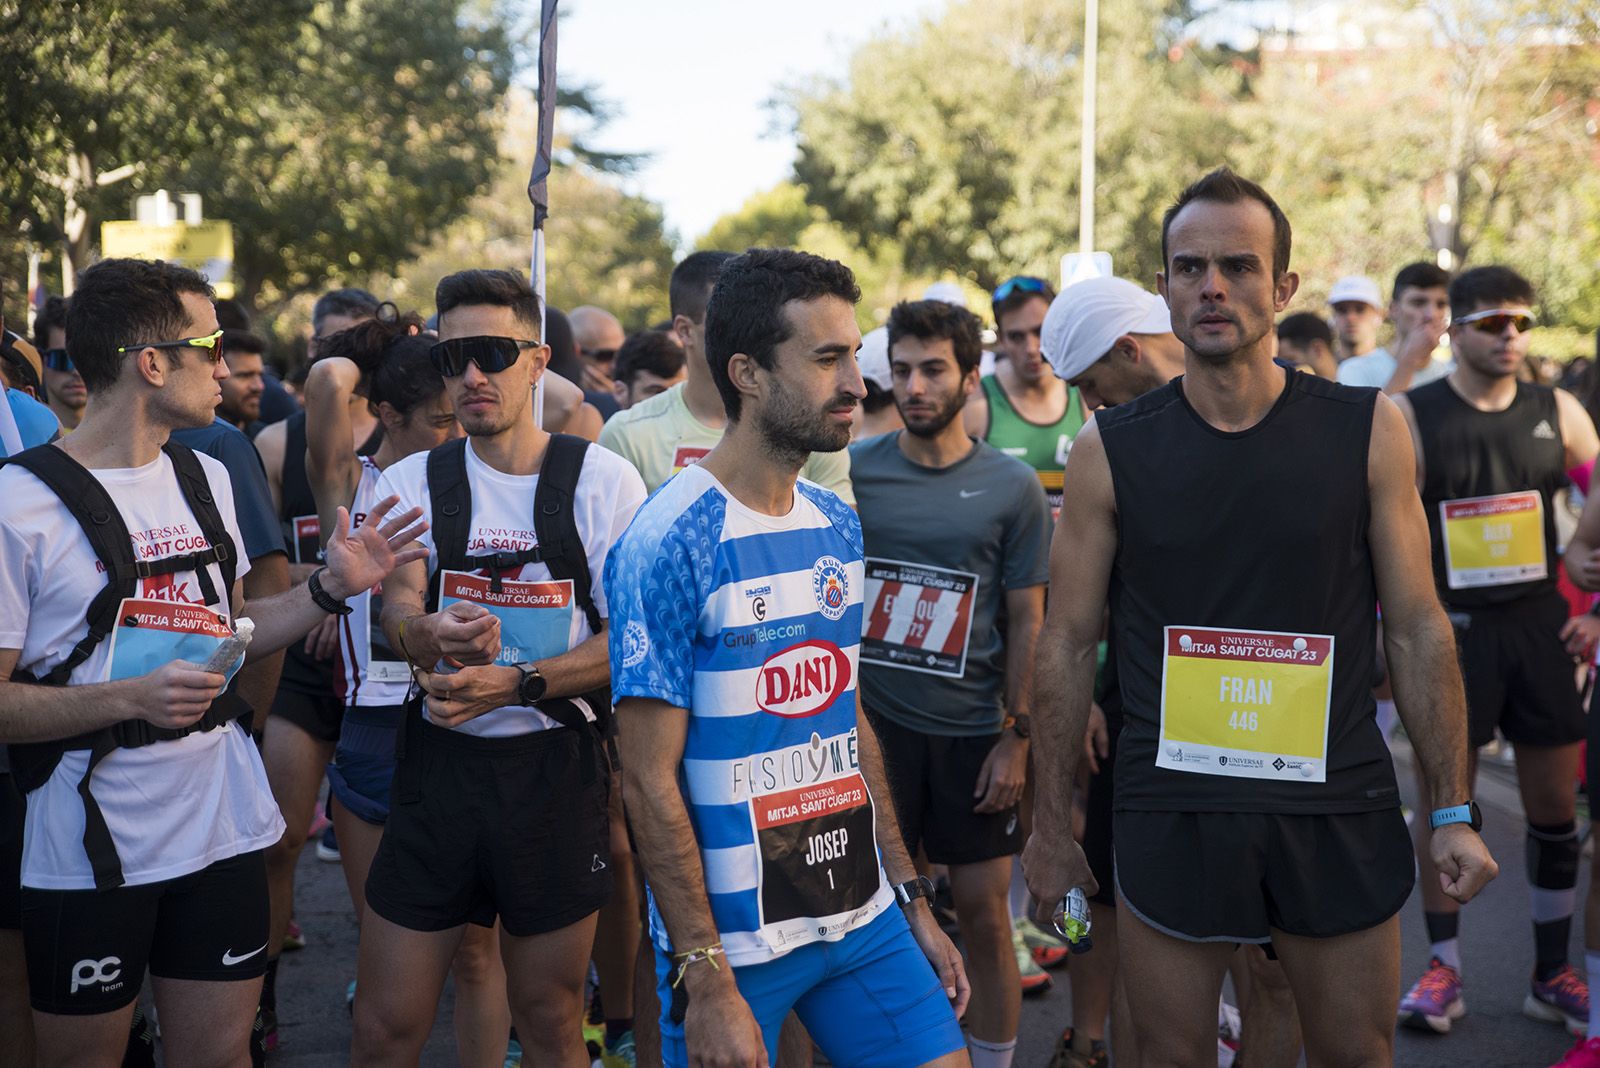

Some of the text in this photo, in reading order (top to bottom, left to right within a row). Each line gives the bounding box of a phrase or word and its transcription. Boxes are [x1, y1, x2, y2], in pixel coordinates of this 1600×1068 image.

[131, 524, 189, 543] NIVERSAE
[139, 541, 172, 558] SANT
[491, 538, 531, 551] SANT
[456, 586, 563, 604] MITJA SANT CUGAT 23
[133, 613, 169, 626] MITJA
[173, 617, 201, 630] SANT
[1221, 636, 1274, 647] UNIVERSAE
[1219, 644, 1254, 656] SANT
[1255, 646, 1298, 659] CUGAT
[1300, 650, 1317, 661] 23
[763, 654, 832, 706] DANI
[1219, 676, 1273, 705] FRAN
[1228, 711, 1258, 731] 446
[1228, 758, 1264, 766] UNIVERSAE
[800, 786, 836, 802] UNIVERSAE
[767, 789, 862, 822] MITJA SANT CUGAT 23
[805, 828, 848, 866] JOSEP
[827, 868, 834, 890] 1
[102, 980, 123, 993] team
